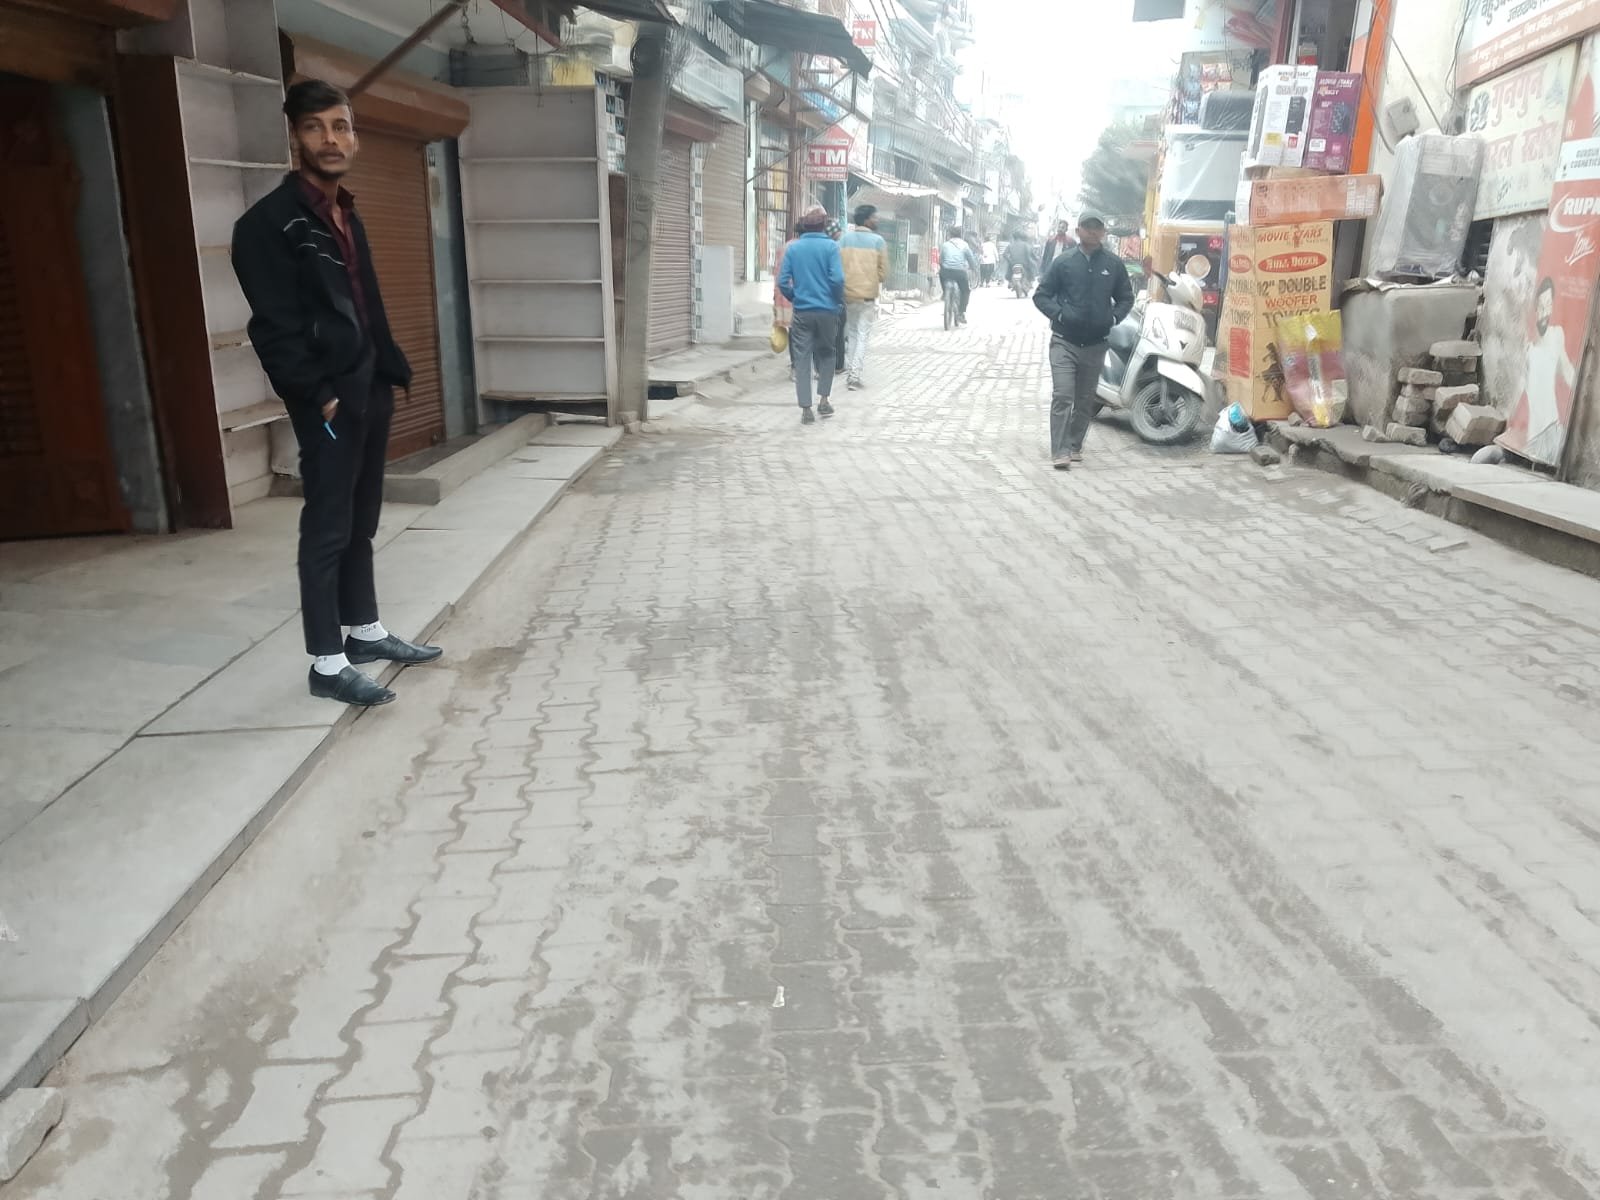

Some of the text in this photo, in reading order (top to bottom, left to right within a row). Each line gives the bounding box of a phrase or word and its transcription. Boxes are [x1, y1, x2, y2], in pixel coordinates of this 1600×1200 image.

[812, 148, 847, 166] TM
[1257, 231, 1290, 243] MOVIE
[1278, 275, 1327, 294] DOUBLE
[1264, 294, 1318, 308] WOOFER
